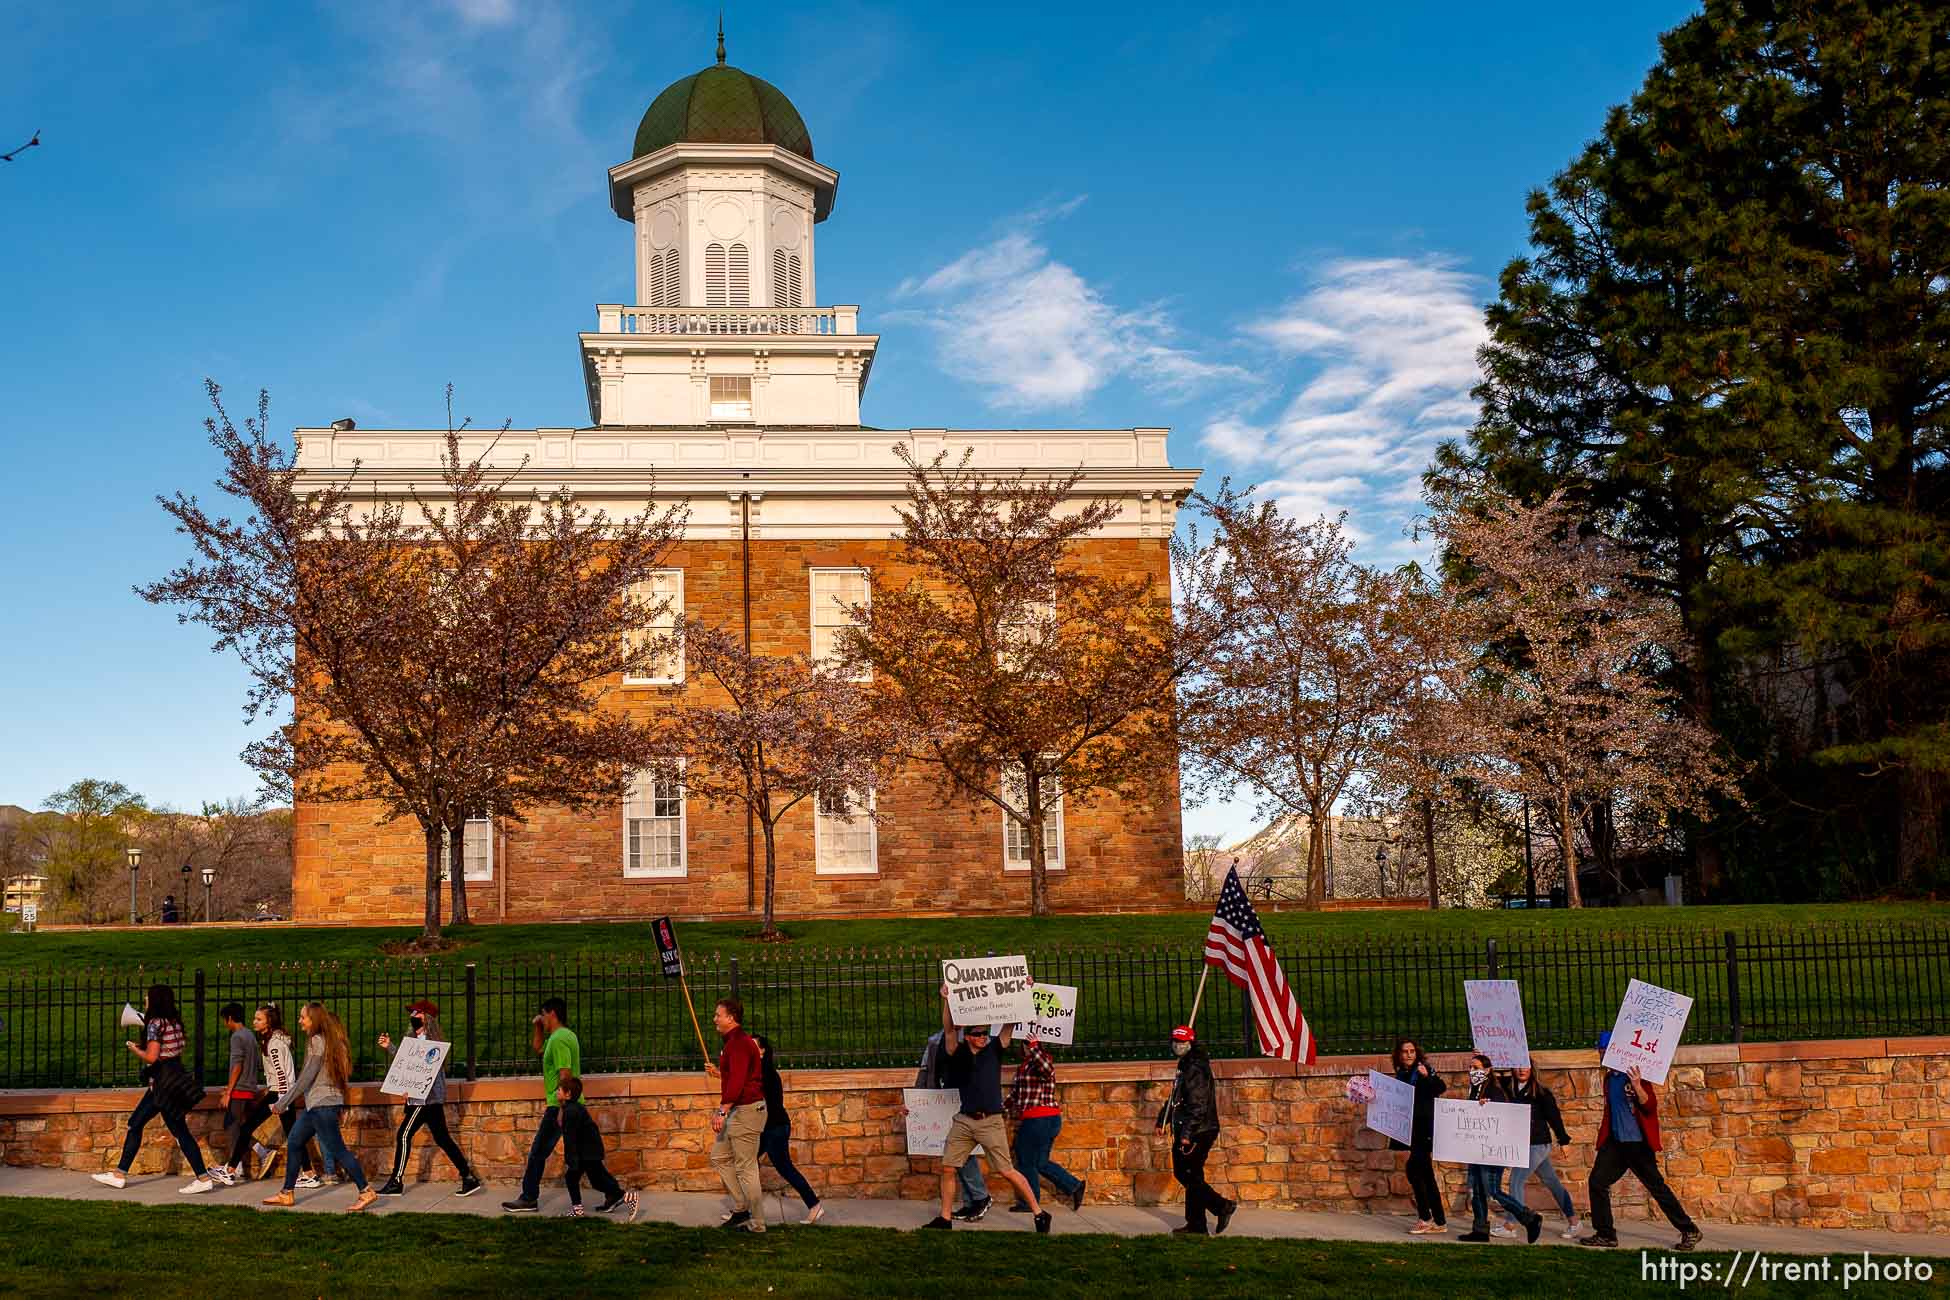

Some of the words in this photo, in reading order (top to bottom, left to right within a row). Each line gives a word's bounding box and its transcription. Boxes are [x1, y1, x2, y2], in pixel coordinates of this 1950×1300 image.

[945, 963, 1026, 984] QUARANTINE
[953, 985, 988, 1001] THIS
[995, 980, 1026, 995] DICK
[1640, 983, 1675, 1004] MAKE
[1046, 1006, 1073, 1018] grow
[1626, 990, 1684, 1019] AMERICA
[1027, 1020, 1062, 1037] trees
[1630, 1029, 1660, 1053] 1st
